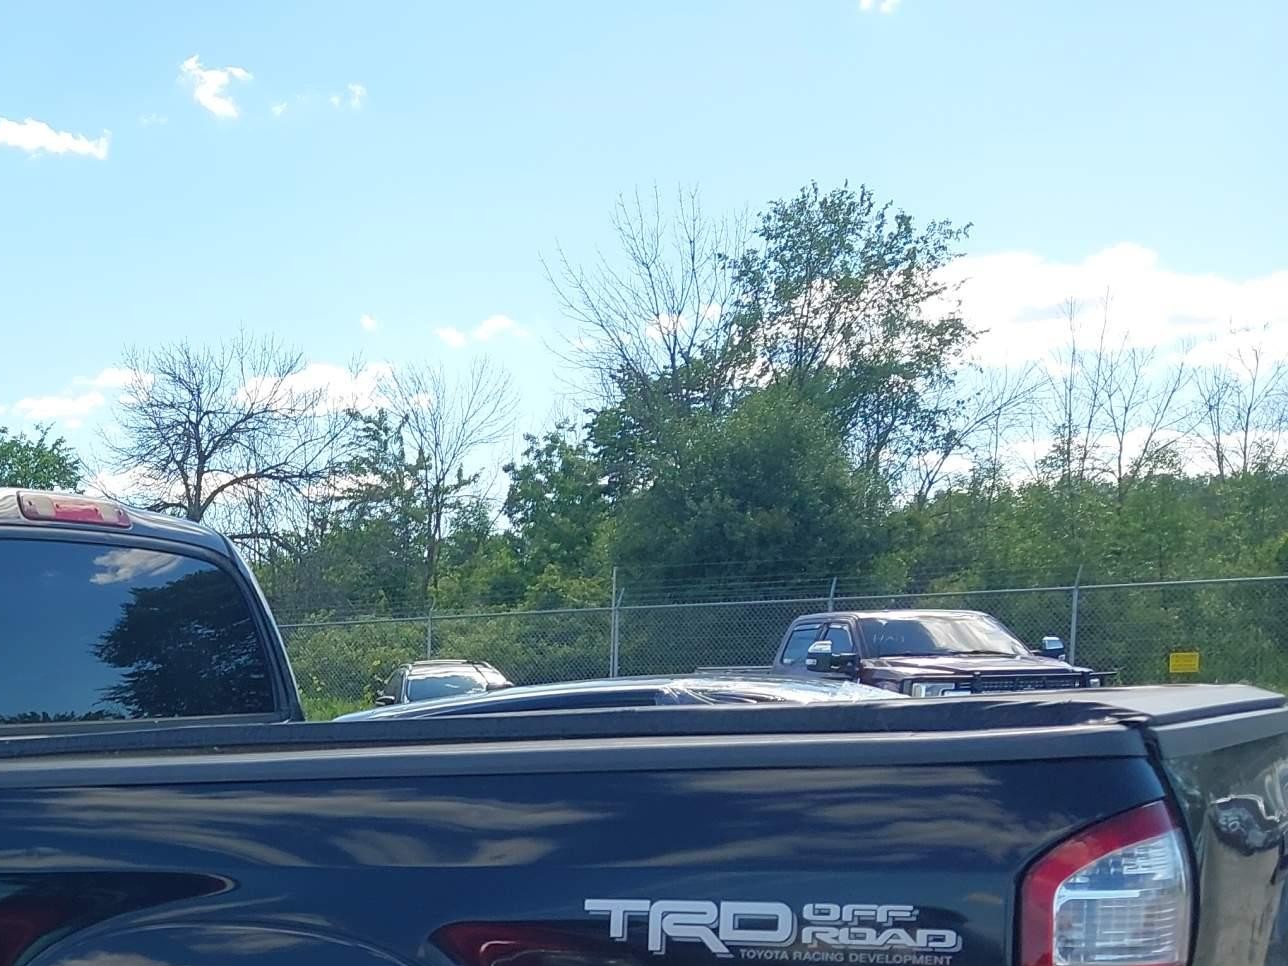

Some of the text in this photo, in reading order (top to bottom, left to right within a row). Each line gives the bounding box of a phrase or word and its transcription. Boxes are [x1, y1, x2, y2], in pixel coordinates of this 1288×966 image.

[802, 903, 919, 925] OFF
[584, 899, 798, 957] TRD
[801, 926, 962, 952] ROAD
[739, 949, 953, 966] TOYOTA RACING DEVELOPMENT
